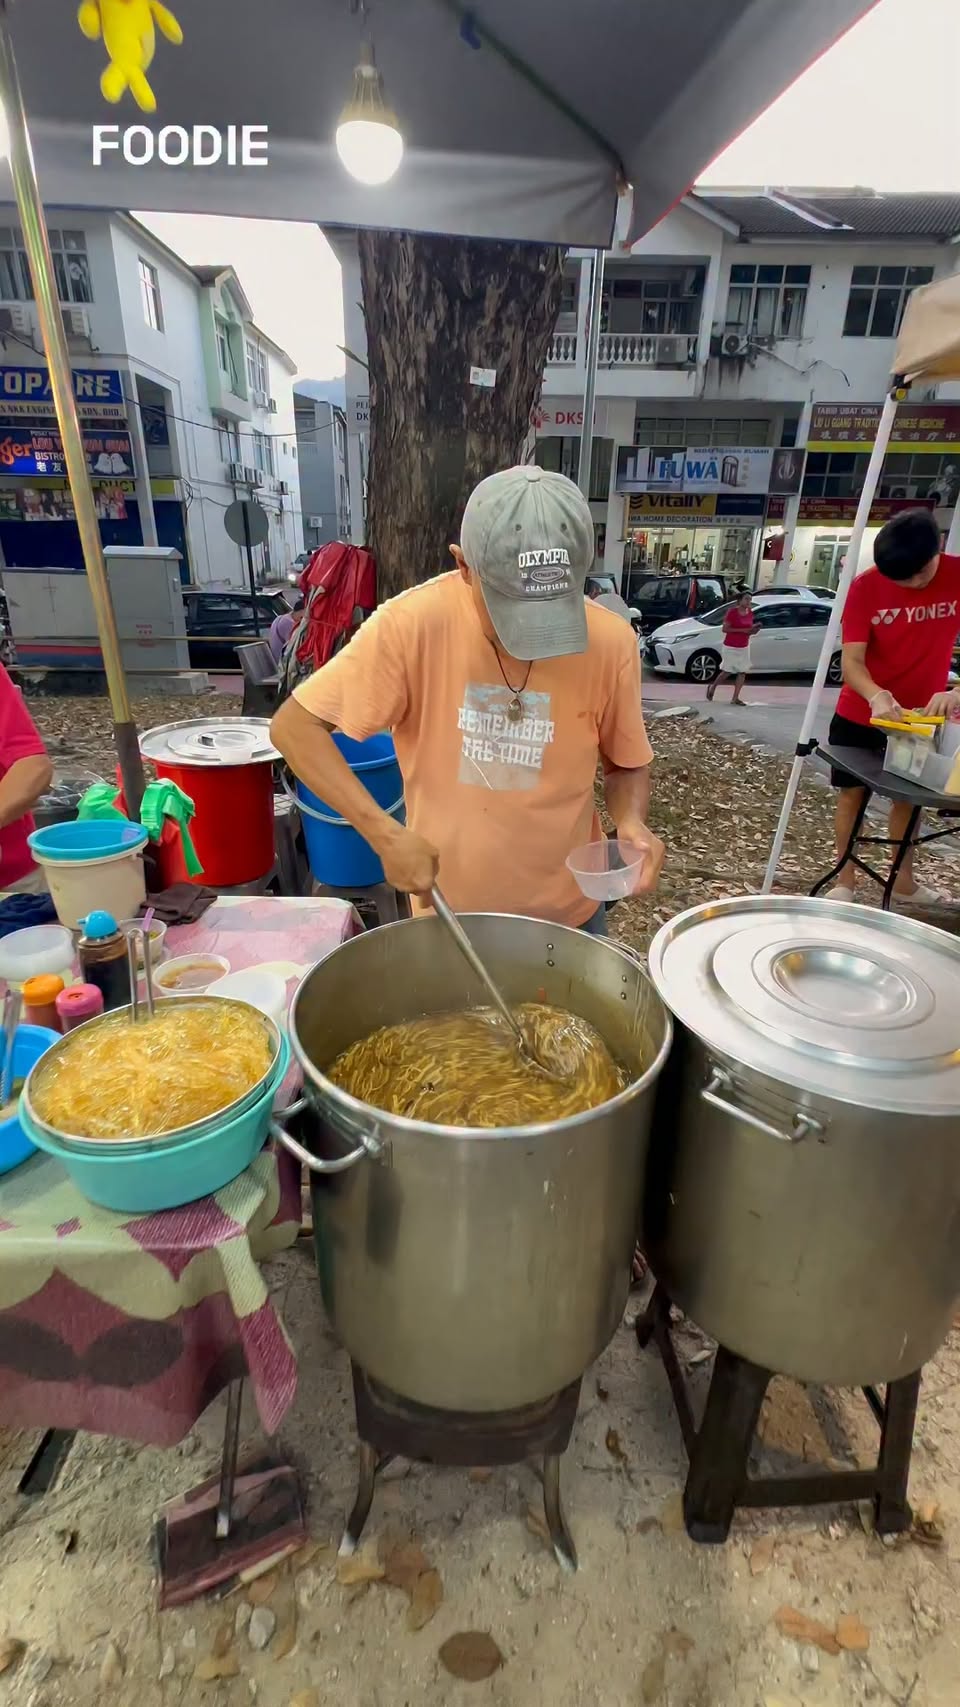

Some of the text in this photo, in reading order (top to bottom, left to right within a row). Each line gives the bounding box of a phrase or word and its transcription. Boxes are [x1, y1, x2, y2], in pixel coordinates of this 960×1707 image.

[0, 371, 111, 397] OPRE
[556, 412, 596, 424] DKS
[35, 452, 65, 461] BISTRO
[518, 548, 571, 569] OLYMPIA
[905, 600, 957, 623] YONEX
[457, 707, 555, 743] REMEMBER
